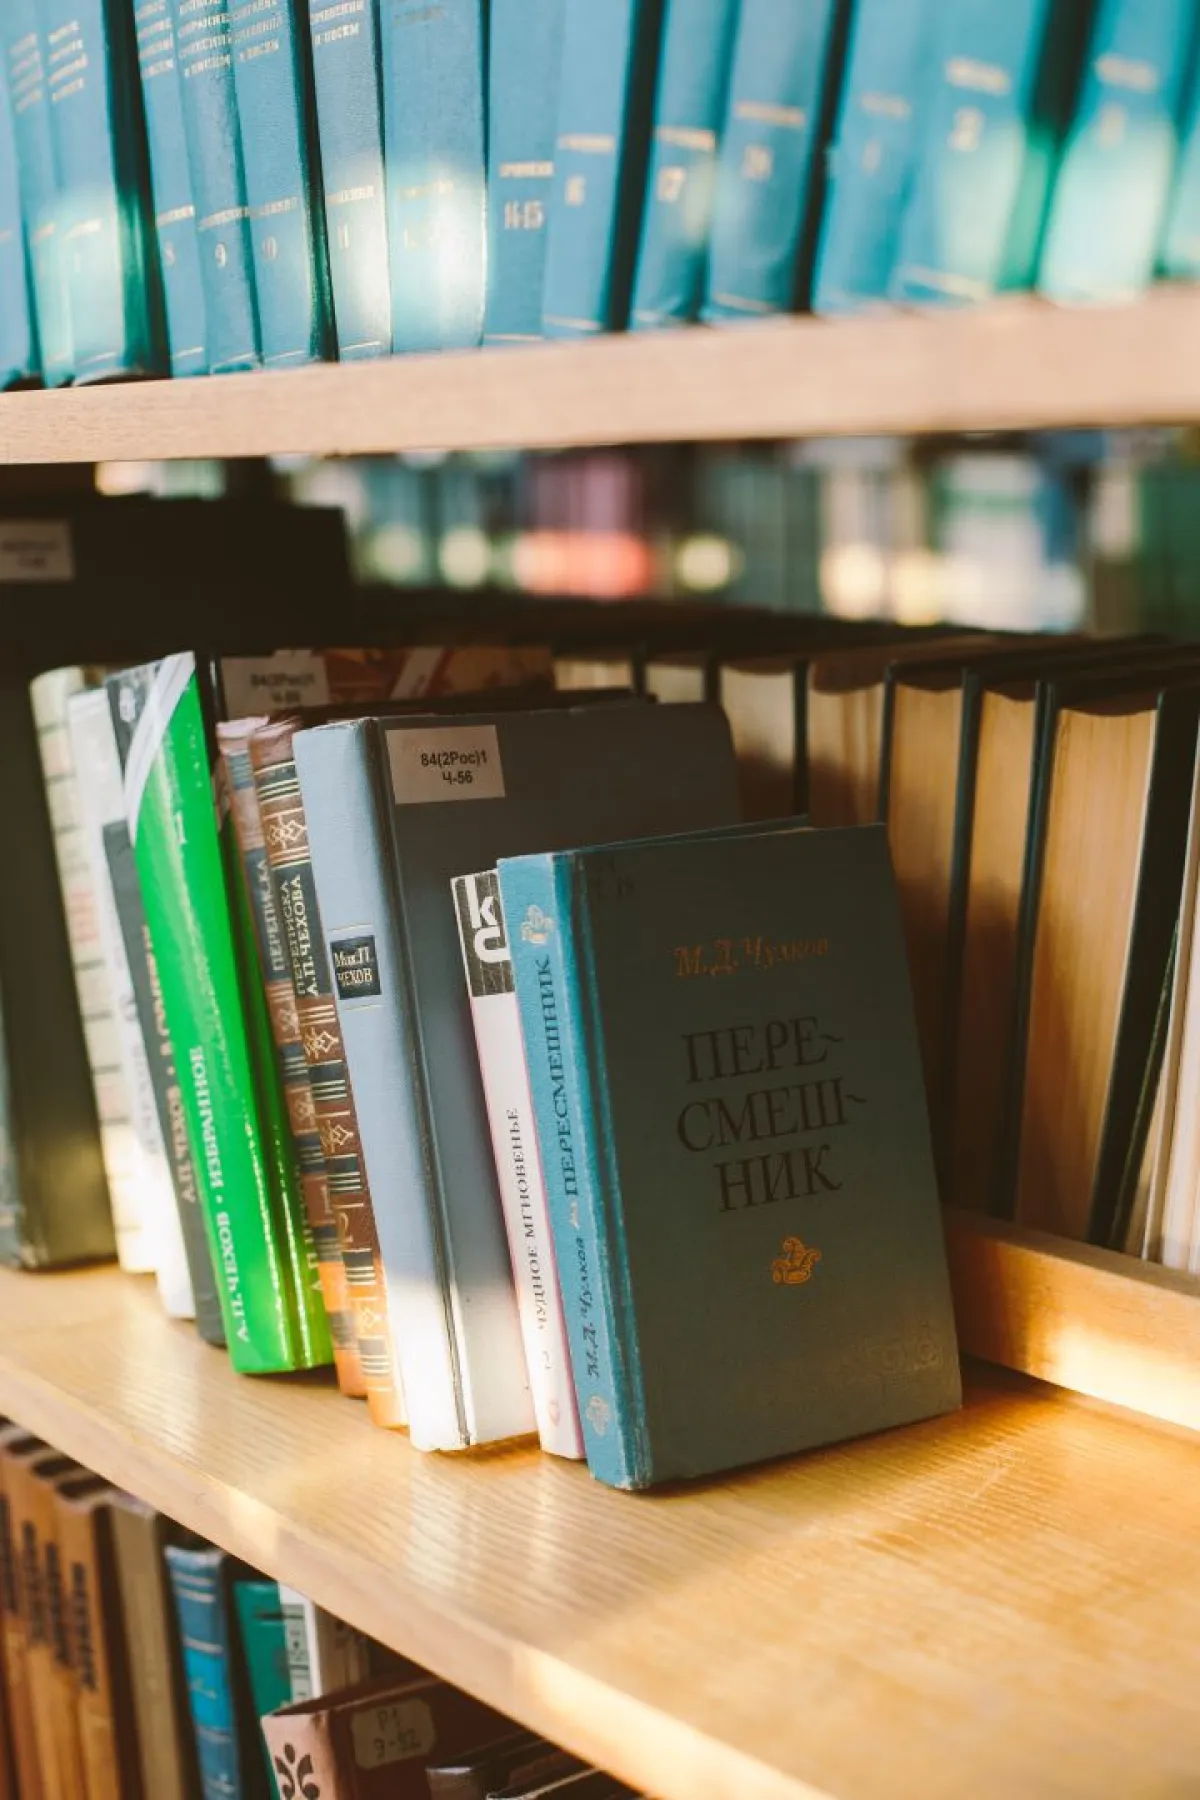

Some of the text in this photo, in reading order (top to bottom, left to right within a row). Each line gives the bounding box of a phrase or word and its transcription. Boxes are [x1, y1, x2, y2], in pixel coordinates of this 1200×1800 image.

[214, 242, 226, 269] 9
[442, 770, 473, 785] Ч-56
[257, 859, 286, 971] ПЕРЕПИСКА
[280, 880, 306, 996] ПЕРЕПИСКА
[190, 1045, 224, 1189] ИЗБРАННОЕ
[535, 954, 578, 1197] ПЕРЕСМЕШНИК
[506, 1106, 536, 1240] МГНОВЕНЬЕ
[713, 1144, 844, 1213] НИК
